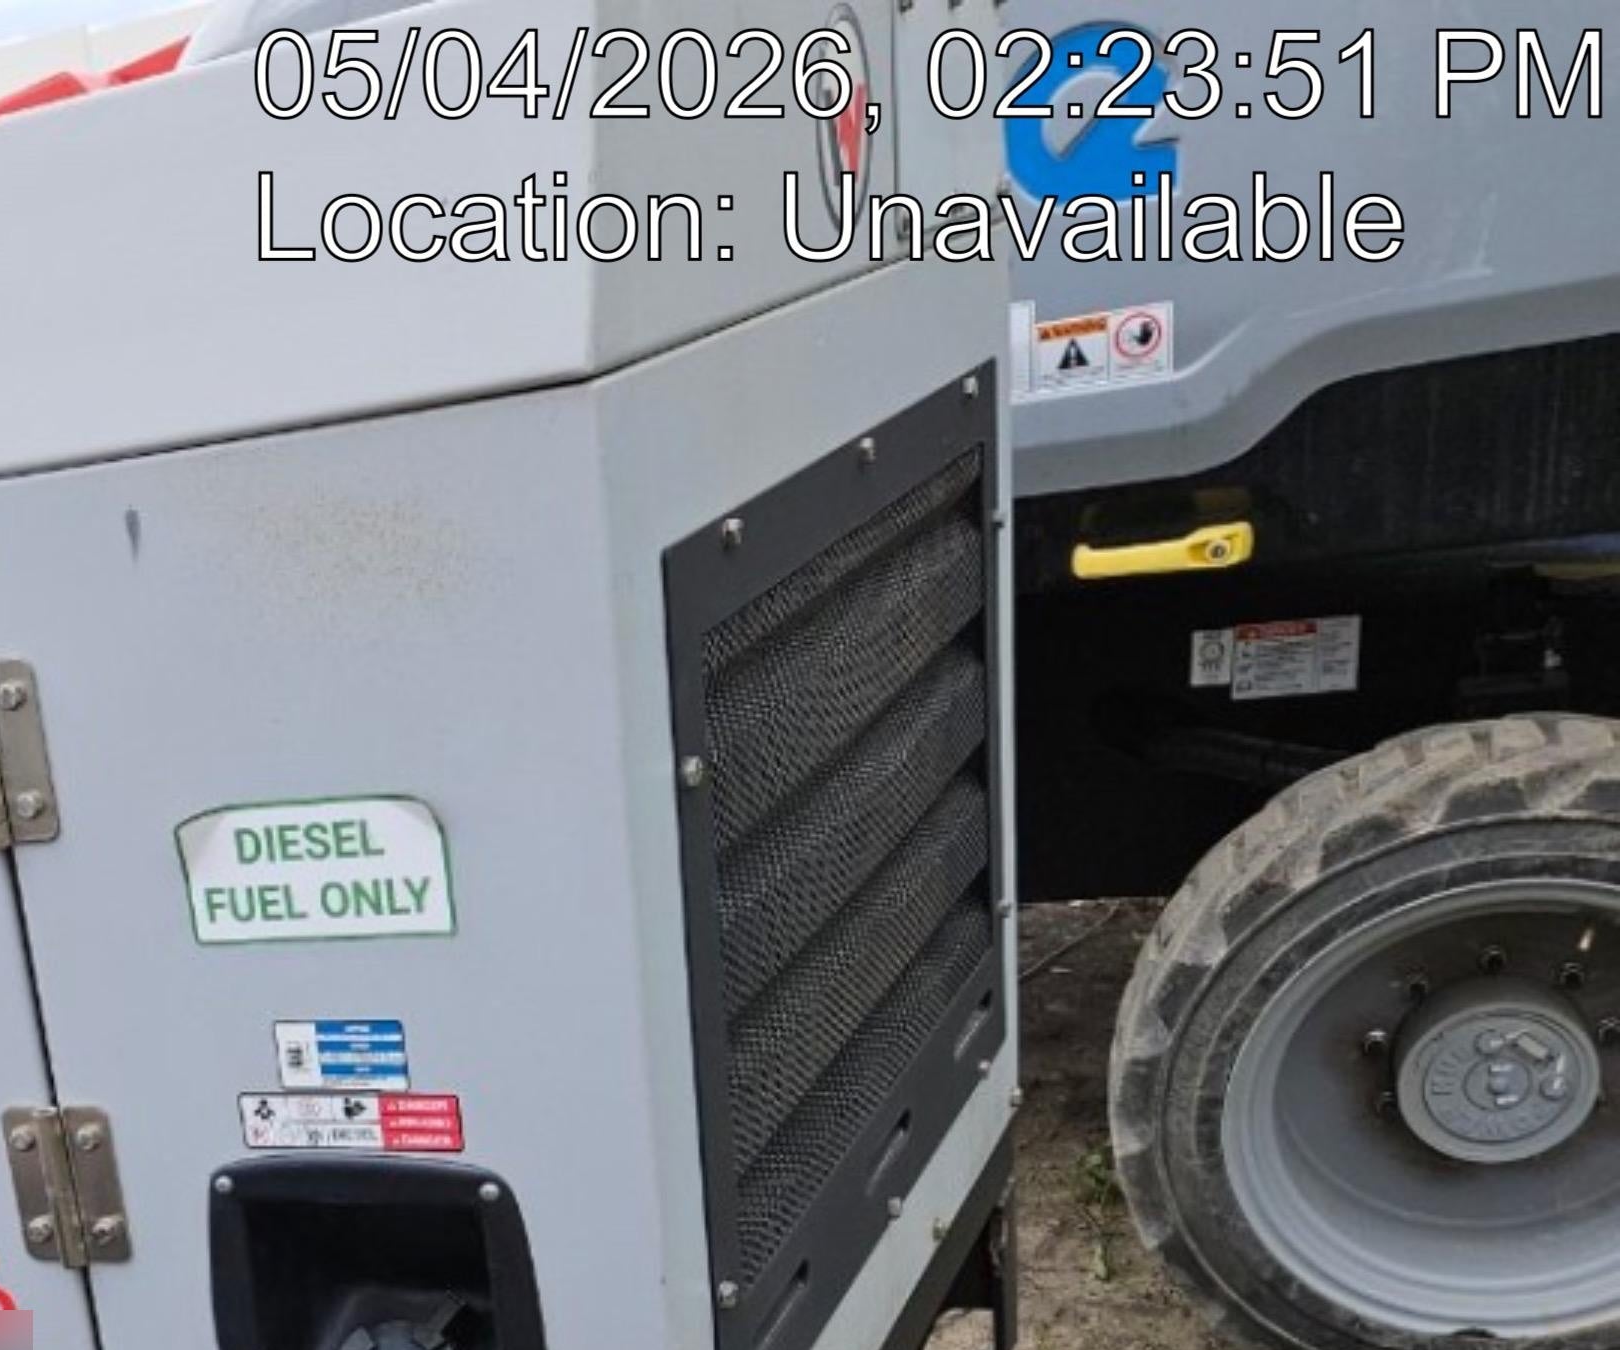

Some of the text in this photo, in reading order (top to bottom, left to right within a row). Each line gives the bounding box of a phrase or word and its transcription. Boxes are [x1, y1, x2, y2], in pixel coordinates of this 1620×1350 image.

[233, 818, 385, 864] DIESEL
[203, 876, 431, 924] FUEL ONLY
